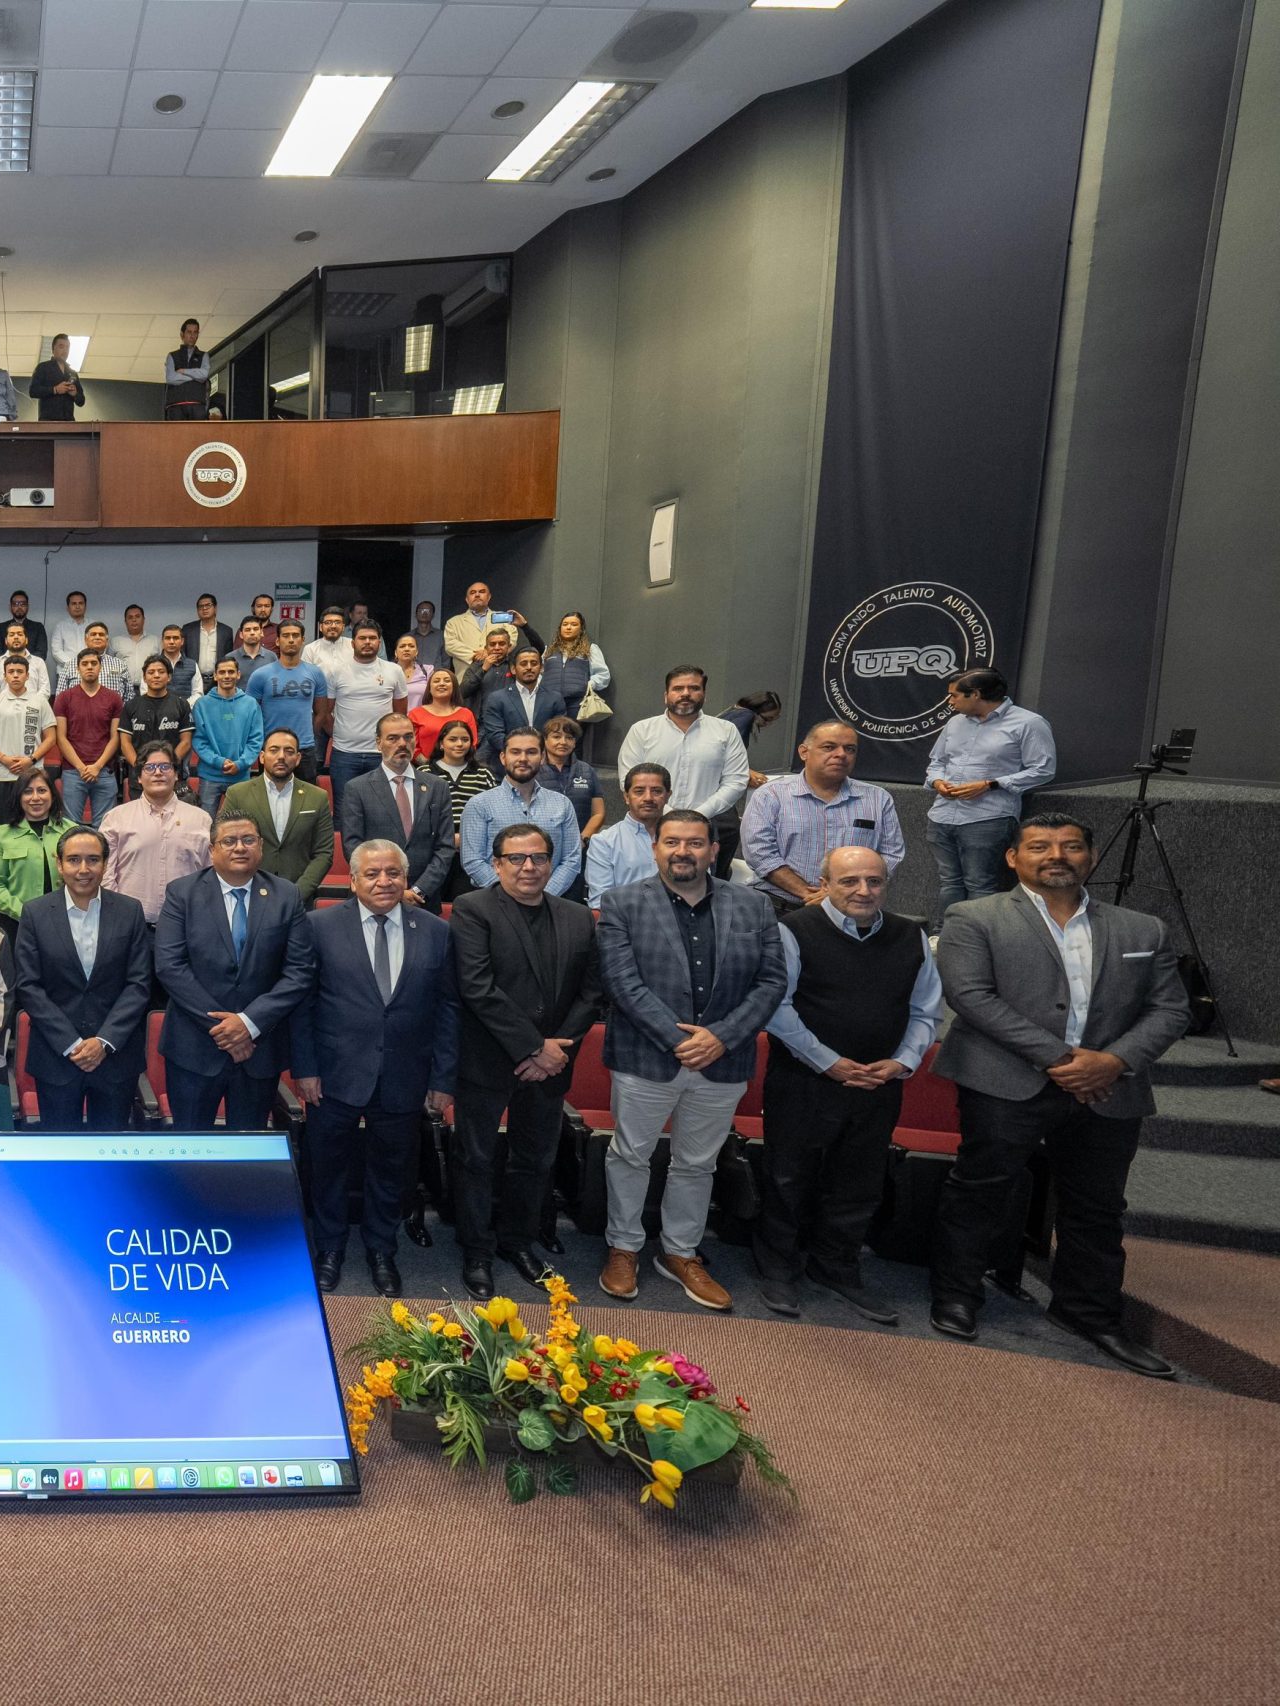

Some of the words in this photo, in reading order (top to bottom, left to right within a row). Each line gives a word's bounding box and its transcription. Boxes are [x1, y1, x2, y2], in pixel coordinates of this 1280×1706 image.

[196, 468, 235, 484] UPQ
[883, 588, 935, 604] TALENTO
[943, 594, 987, 659] AUTOMOTRIZ
[852, 645, 959, 679] UPQ
[272, 677, 312, 698] Lee
[830, 679, 859, 722] UNIVERSIDAD
[862, 721, 918, 734] POLITÉCNICA
[922, 717, 936, 728] DE
[937, 703, 956, 720] QUE
[106, 1228, 232, 1256] CALIDAD
[109, 1264, 149, 1291] DE
[156, 1263, 229, 1291] VIDA
[111, 1312, 160, 1324] ALCALDE
[112, 1329, 190, 1344] GUERRERO
